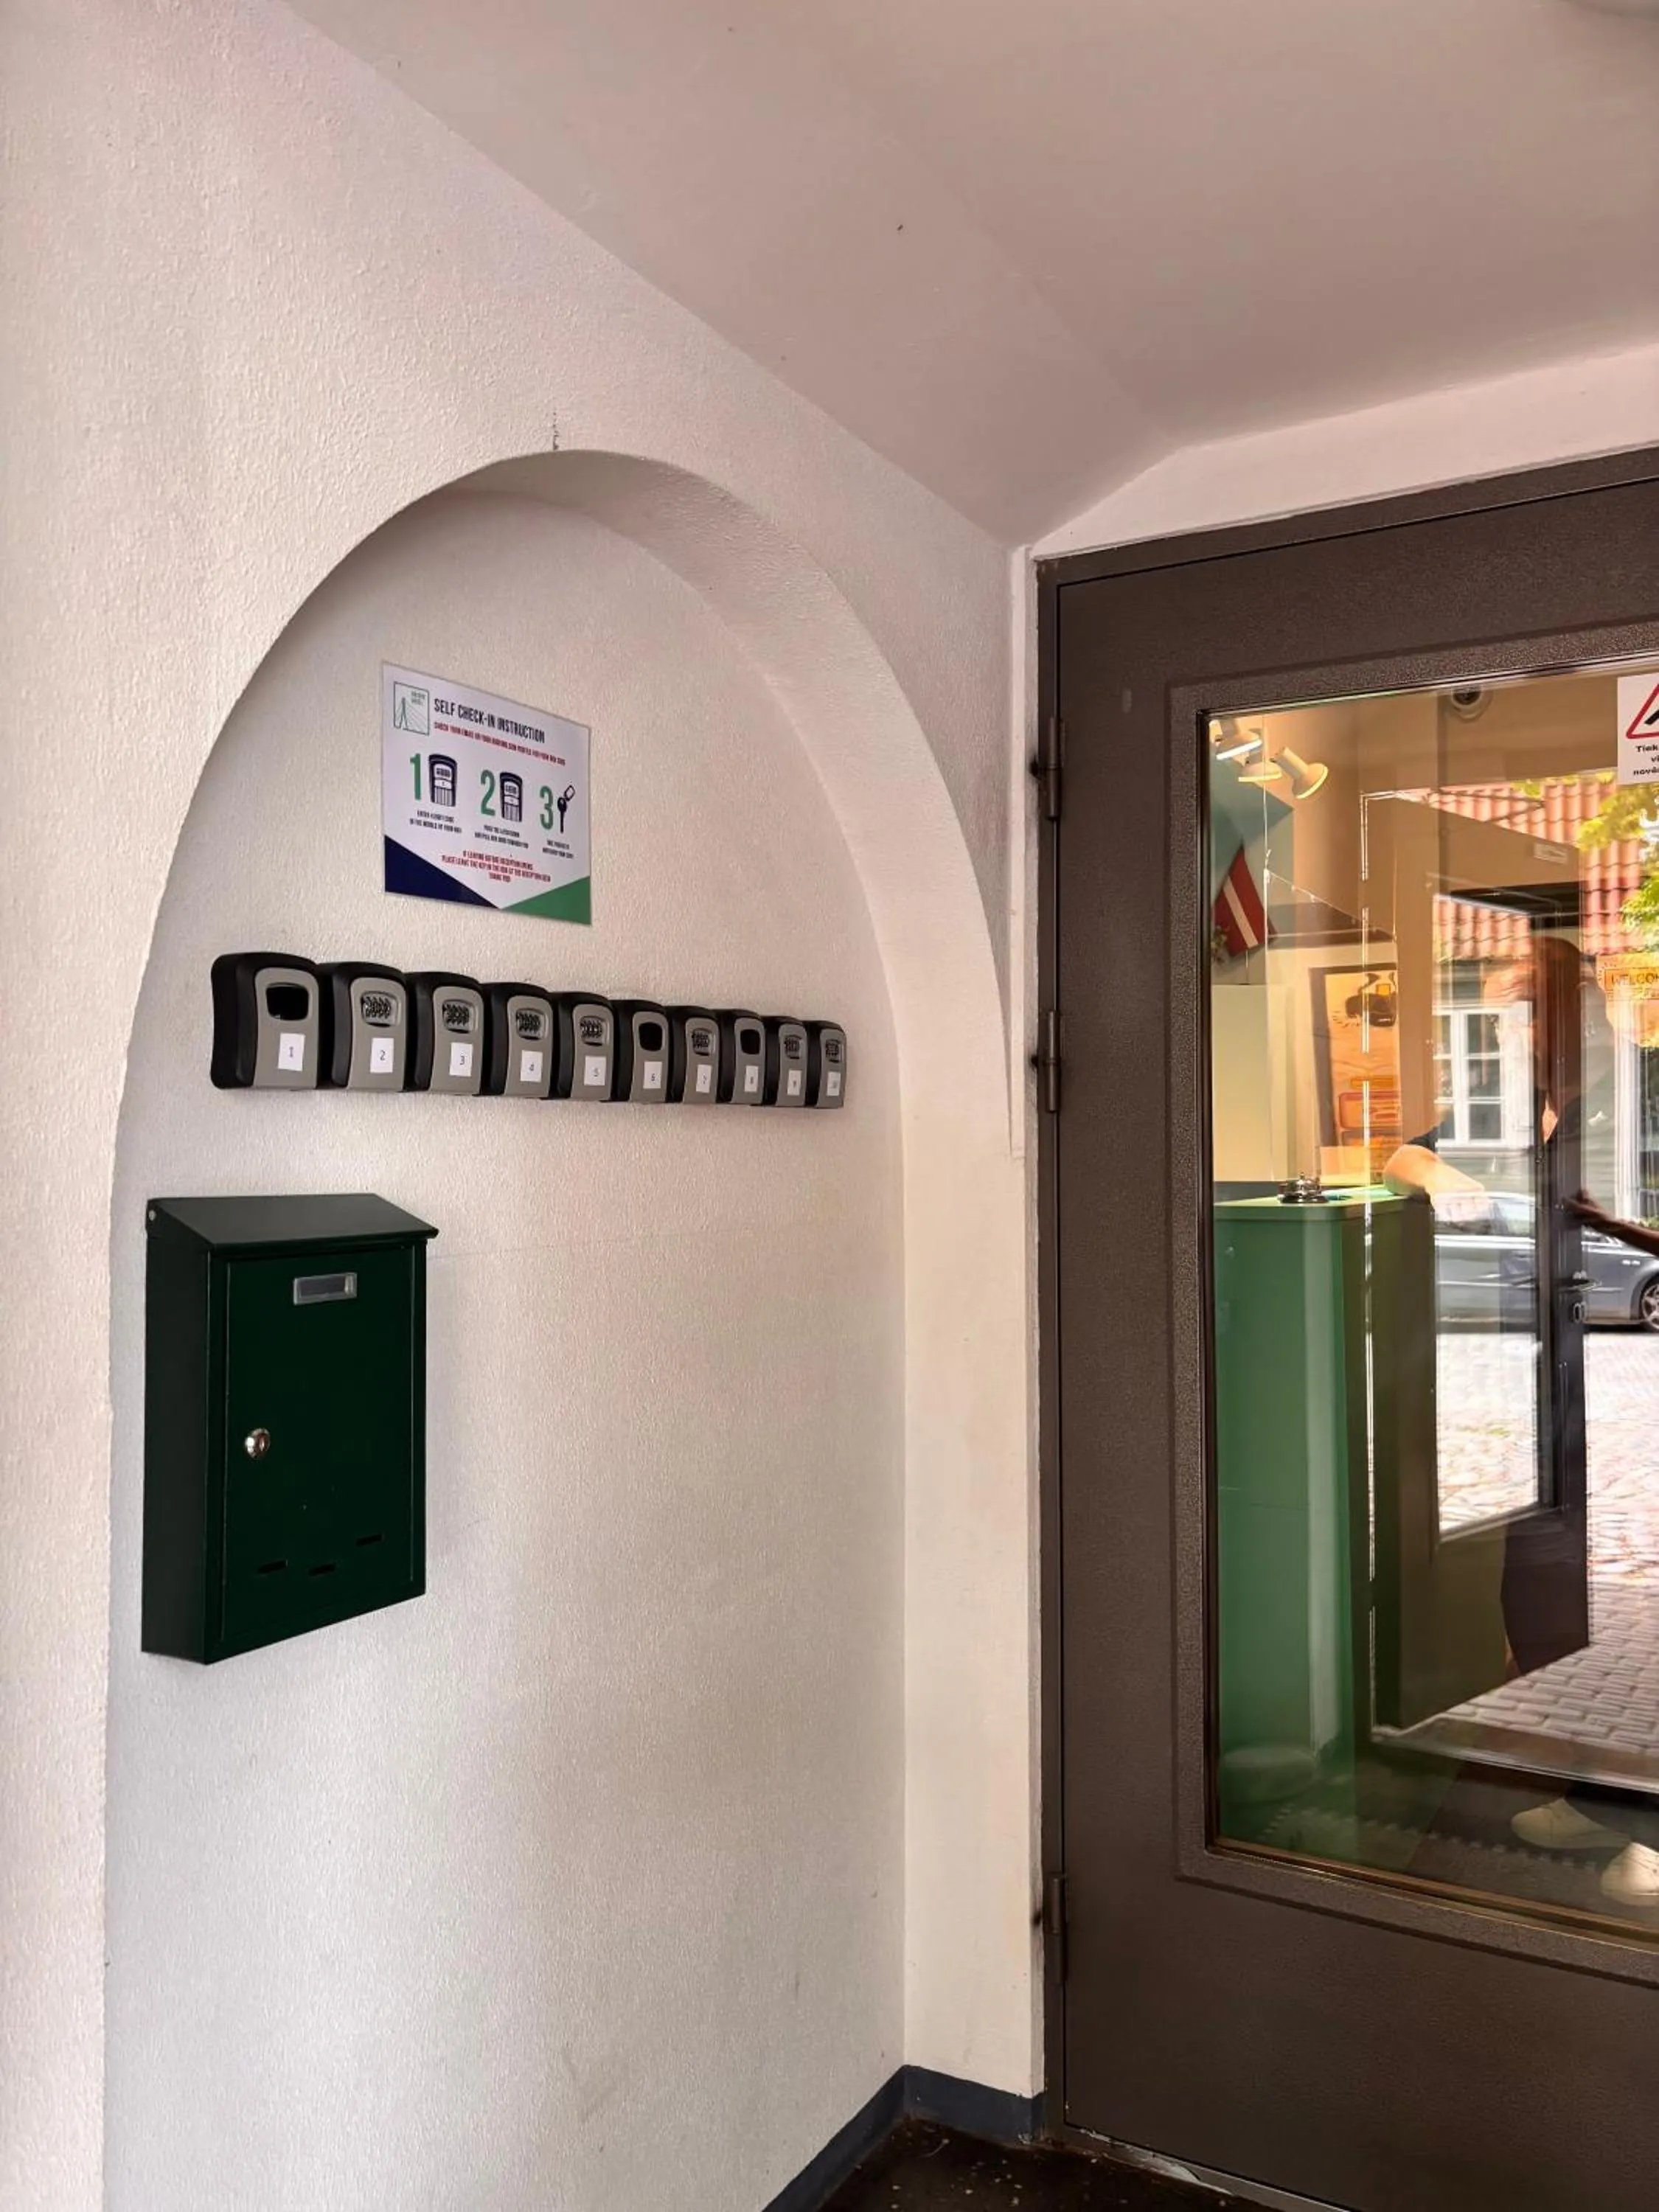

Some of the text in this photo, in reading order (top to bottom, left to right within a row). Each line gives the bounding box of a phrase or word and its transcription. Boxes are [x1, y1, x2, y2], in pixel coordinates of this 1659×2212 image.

[434, 698, 456, 716] SELF
[458, 704, 495, 728] CHECK-IN
[497, 717, 545, 743] INSTRUCTION
[410, 753, 422, 801] 1
[1633, 766, 1659, 775] novē
[480, 769, 496, 816] 2
[540, 785, 554, 830] 3
[289, 1046, 294, 1059] 1
[380, 1049, 387, 1062] 2
[459, 1050, 465, 1065] 3
